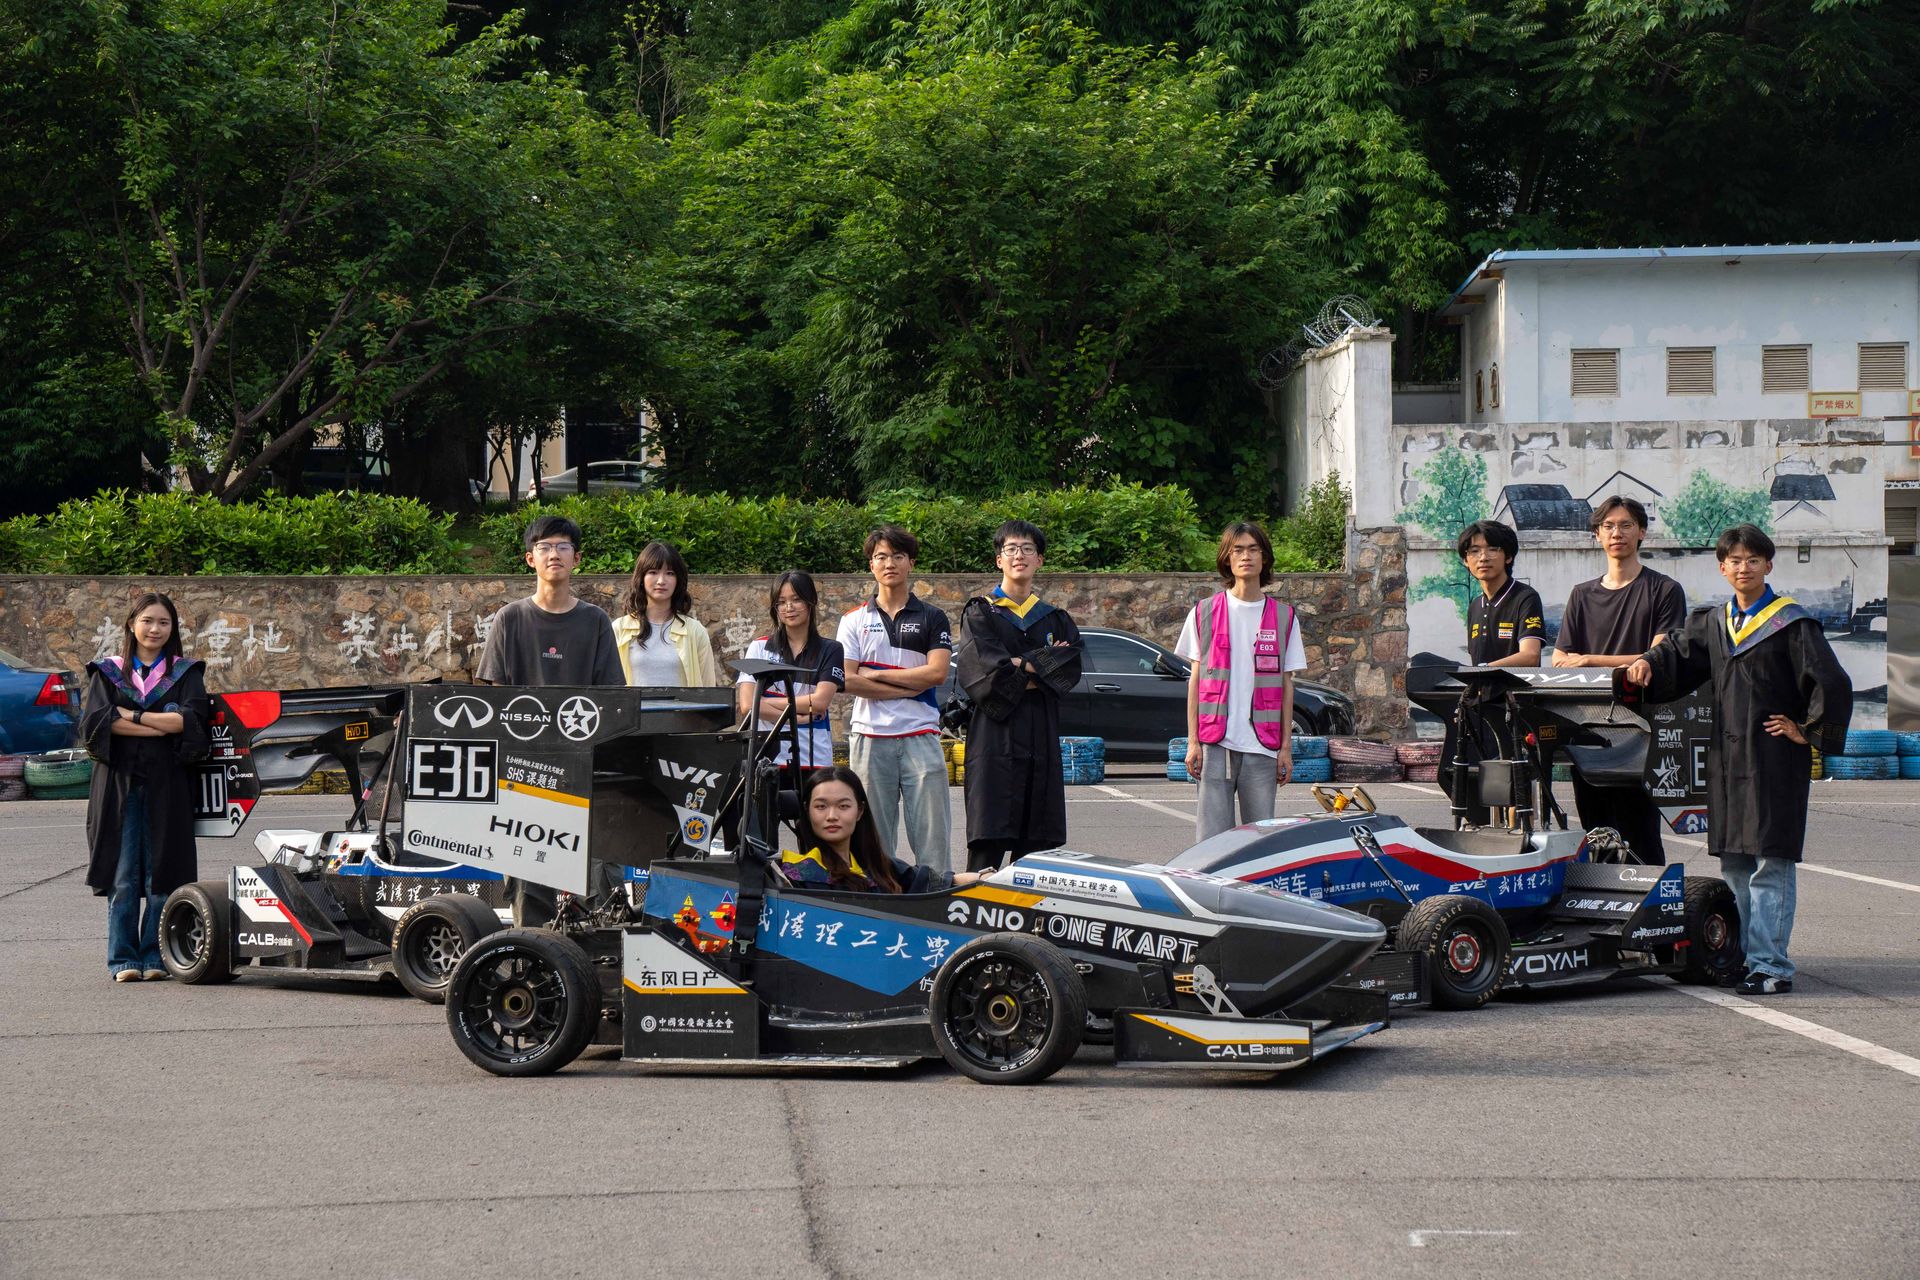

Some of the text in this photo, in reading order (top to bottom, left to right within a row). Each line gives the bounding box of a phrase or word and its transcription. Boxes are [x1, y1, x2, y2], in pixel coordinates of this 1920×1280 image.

[500, 713, 551, 723] NISSAN
[1658, 729, 1683, 741] SMT
[413, 744, 491, 798] E36
[506, 767, 558, 790] SHS 课题组
[489, 815, 580, 852] HIOKI
[407, 829, 484, 860] Continental
[513, 845, 547, 864] 日置
[1038, 875, 1118, 893] 中国汽车工程学会
[1260, 873, 1307, 896] 汽车
[1448, 881, 1486, 893] EVE
[1661, 902, 1684, 913] CALB
[238, 932, 275, 946] CALB
[976, 906, 1199, 964] NIO ONE KART
[1508, 949, 1588, 975] VOYAH
[640, 971, 720, 987] 东风日产
[1206, 1044, 1294, 1057] CALB 中创新航
